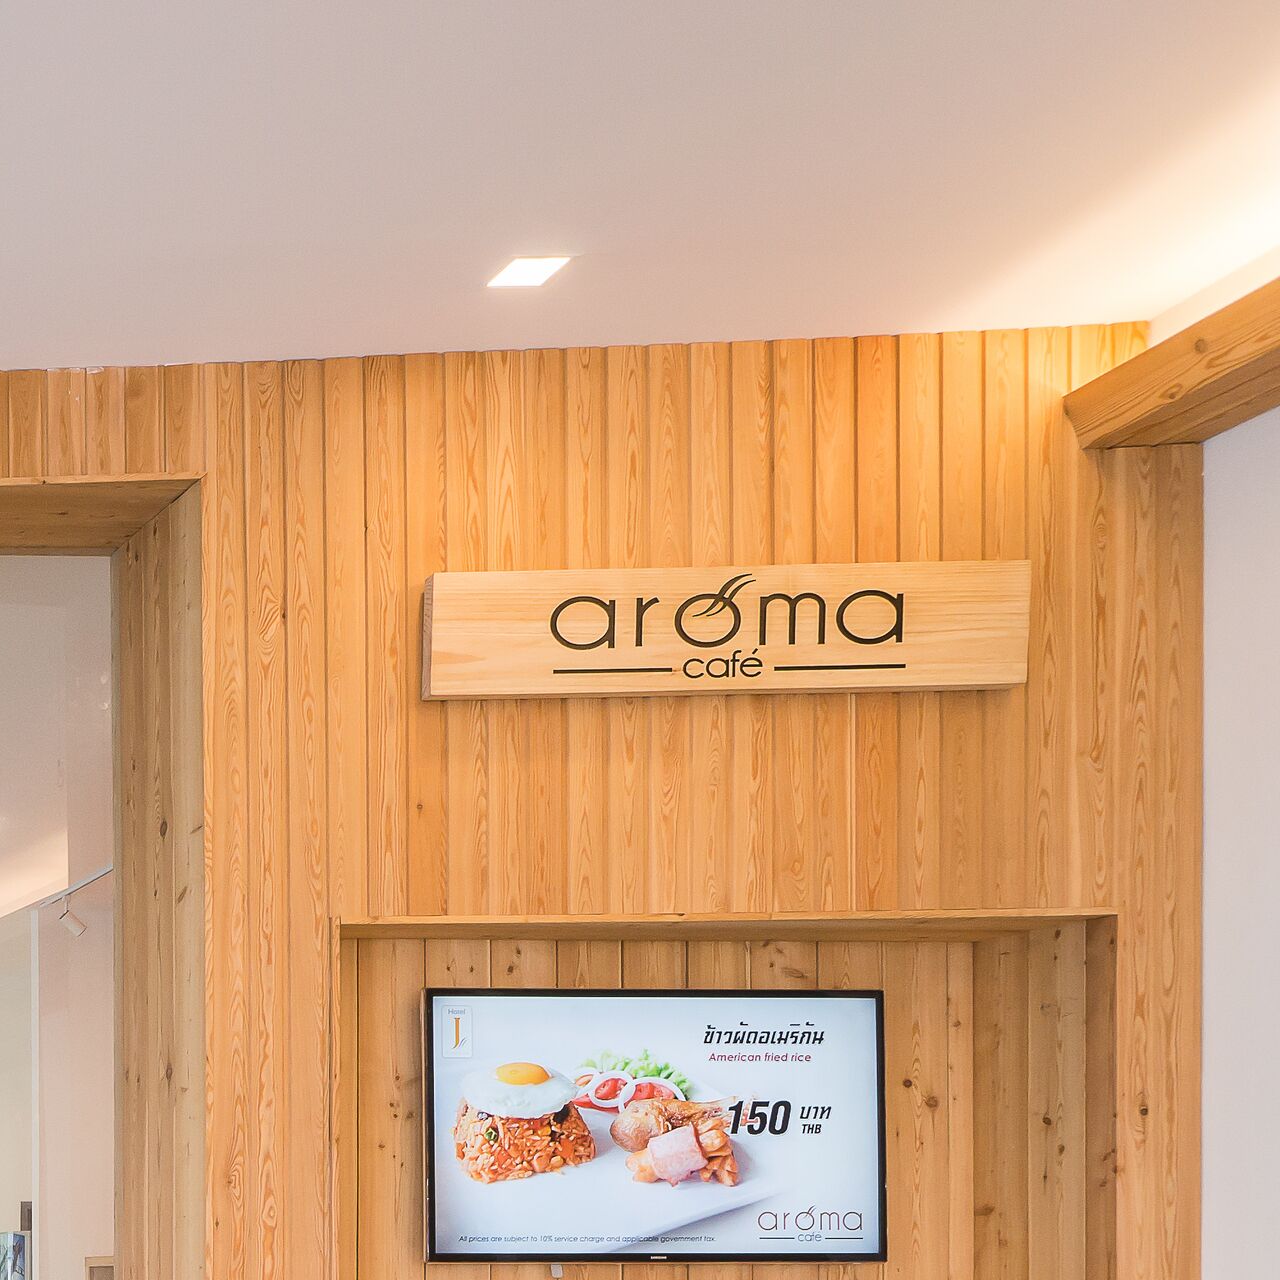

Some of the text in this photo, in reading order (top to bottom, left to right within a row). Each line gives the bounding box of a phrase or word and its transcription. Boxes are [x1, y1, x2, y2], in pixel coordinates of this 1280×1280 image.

[683, 648, 763, 679] café
[703, 1021, 825, 1045] ข้าวผัดอเมริกัน
[708, 1052, 812, 1062] American fried rice
[728, 1100, 792, 1135] 150
[799, 1106, 832, 1120] บาท
[801, 1123, 822, 1134] THB
